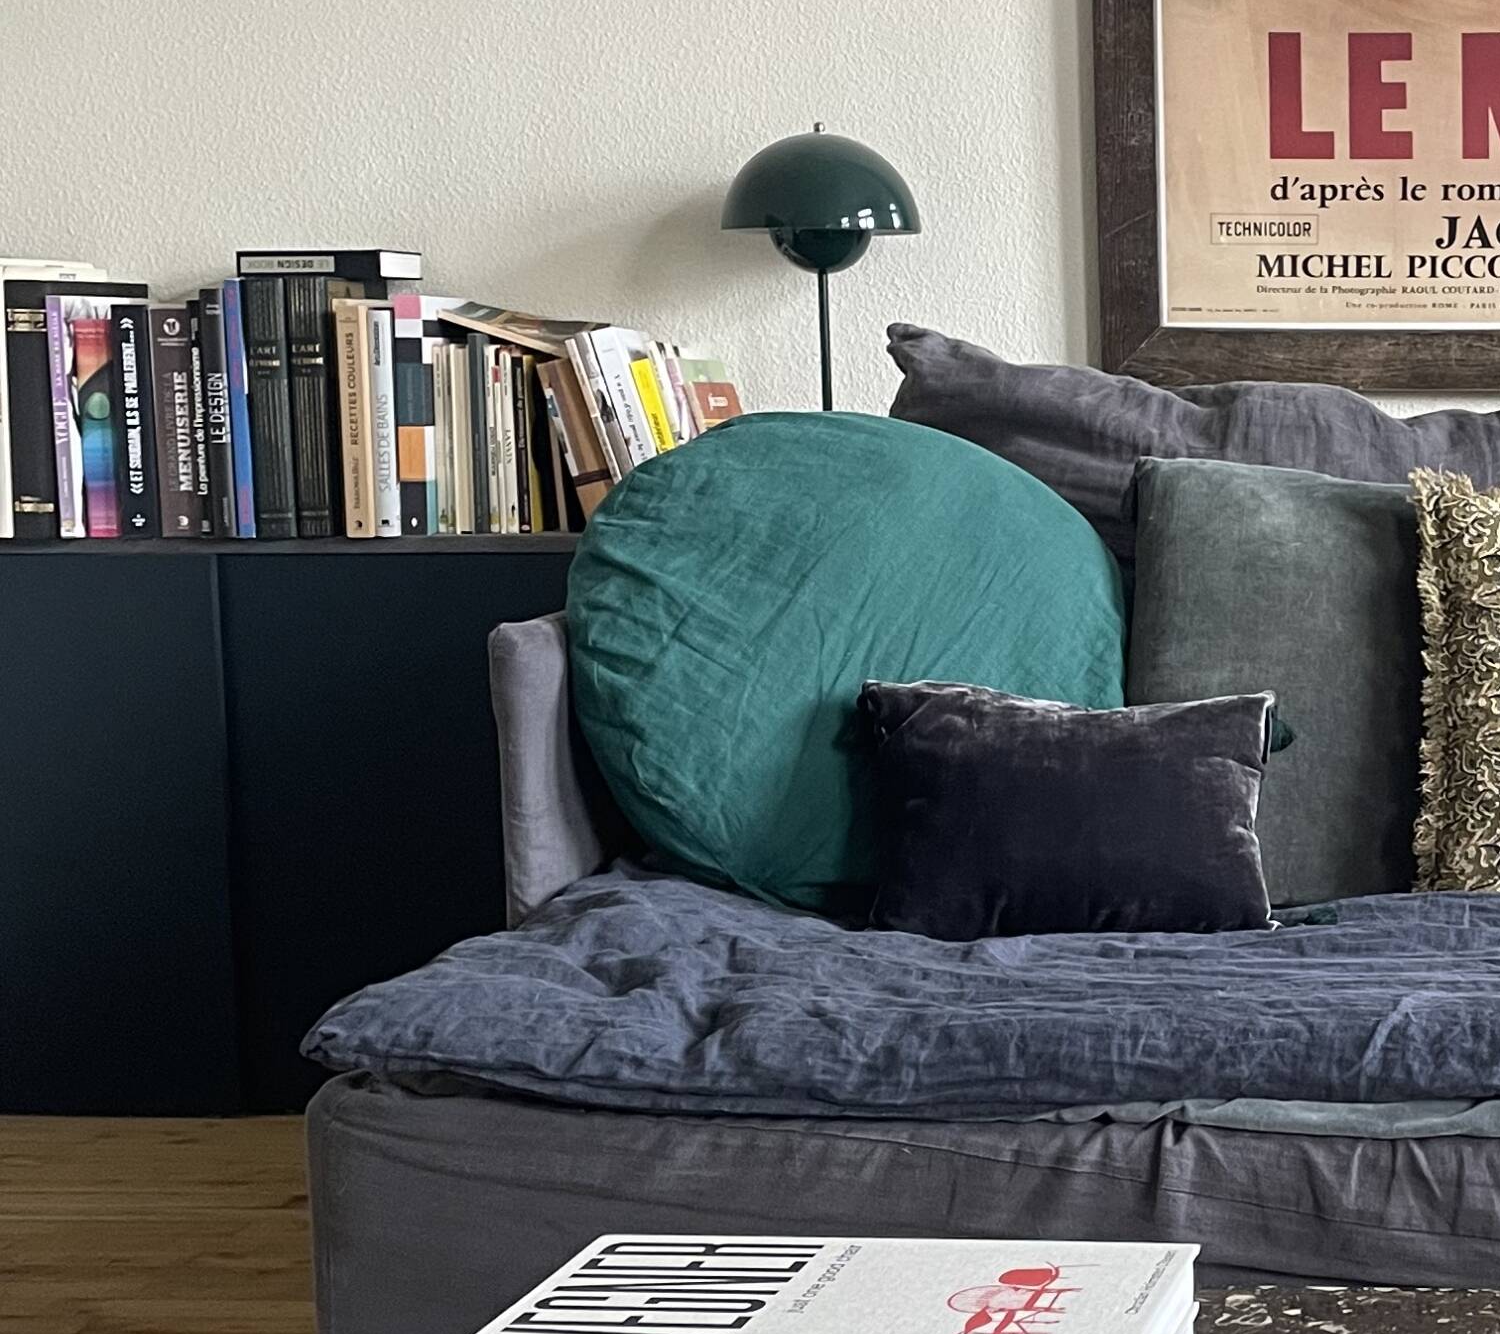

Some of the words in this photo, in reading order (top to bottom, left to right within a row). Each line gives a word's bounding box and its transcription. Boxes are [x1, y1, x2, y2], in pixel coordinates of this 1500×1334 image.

[1268, 31, 1413, 160] LE
[1270, 175, 1385, 209] d'après
[1400, 176, 1427, 202] le
[1217, 221, 1312, 238] TECHNICOLOR
[277, 259, 314, 269] DESIGN
[1256, 253, 1393, 279] MICHEL
[1256, 285, 1301, 294] Directeur
[1304, 285, 1317, 294] de
[1319, 285, 1328, 294] la
[1331, 285, 1397, 297] Photographie
[1401, 285, 1438, 295] RAOUL
[291, 343, 320, 353] L'ART
[344, 332, 357, 390] COULEURS
[207, 372, 225, 424] DESIGN
[374, 393, 389, 429] BAINS
[51, 398, 69, 444] VOGUE
[164, 405, 175, 436] LIVRE
[173, 371, 193, 492] MENUISERIE
[193, 428, 205, 443] de
[209, 425, 226, 444] LE
[348, 393, 360, 446] RECETTES
[376, 431, 390, 447] DE
[165, 438, 177, 477] GRAND
[195, 444, 209, 483] peinture
[376, 448, 391, 493] SALLES
[197, 483, 209, 496] La
[802, 1283, 825, 1298] one
[817, 1263, 846, 1282] good
[836, 1244, 862, 1262] chair
